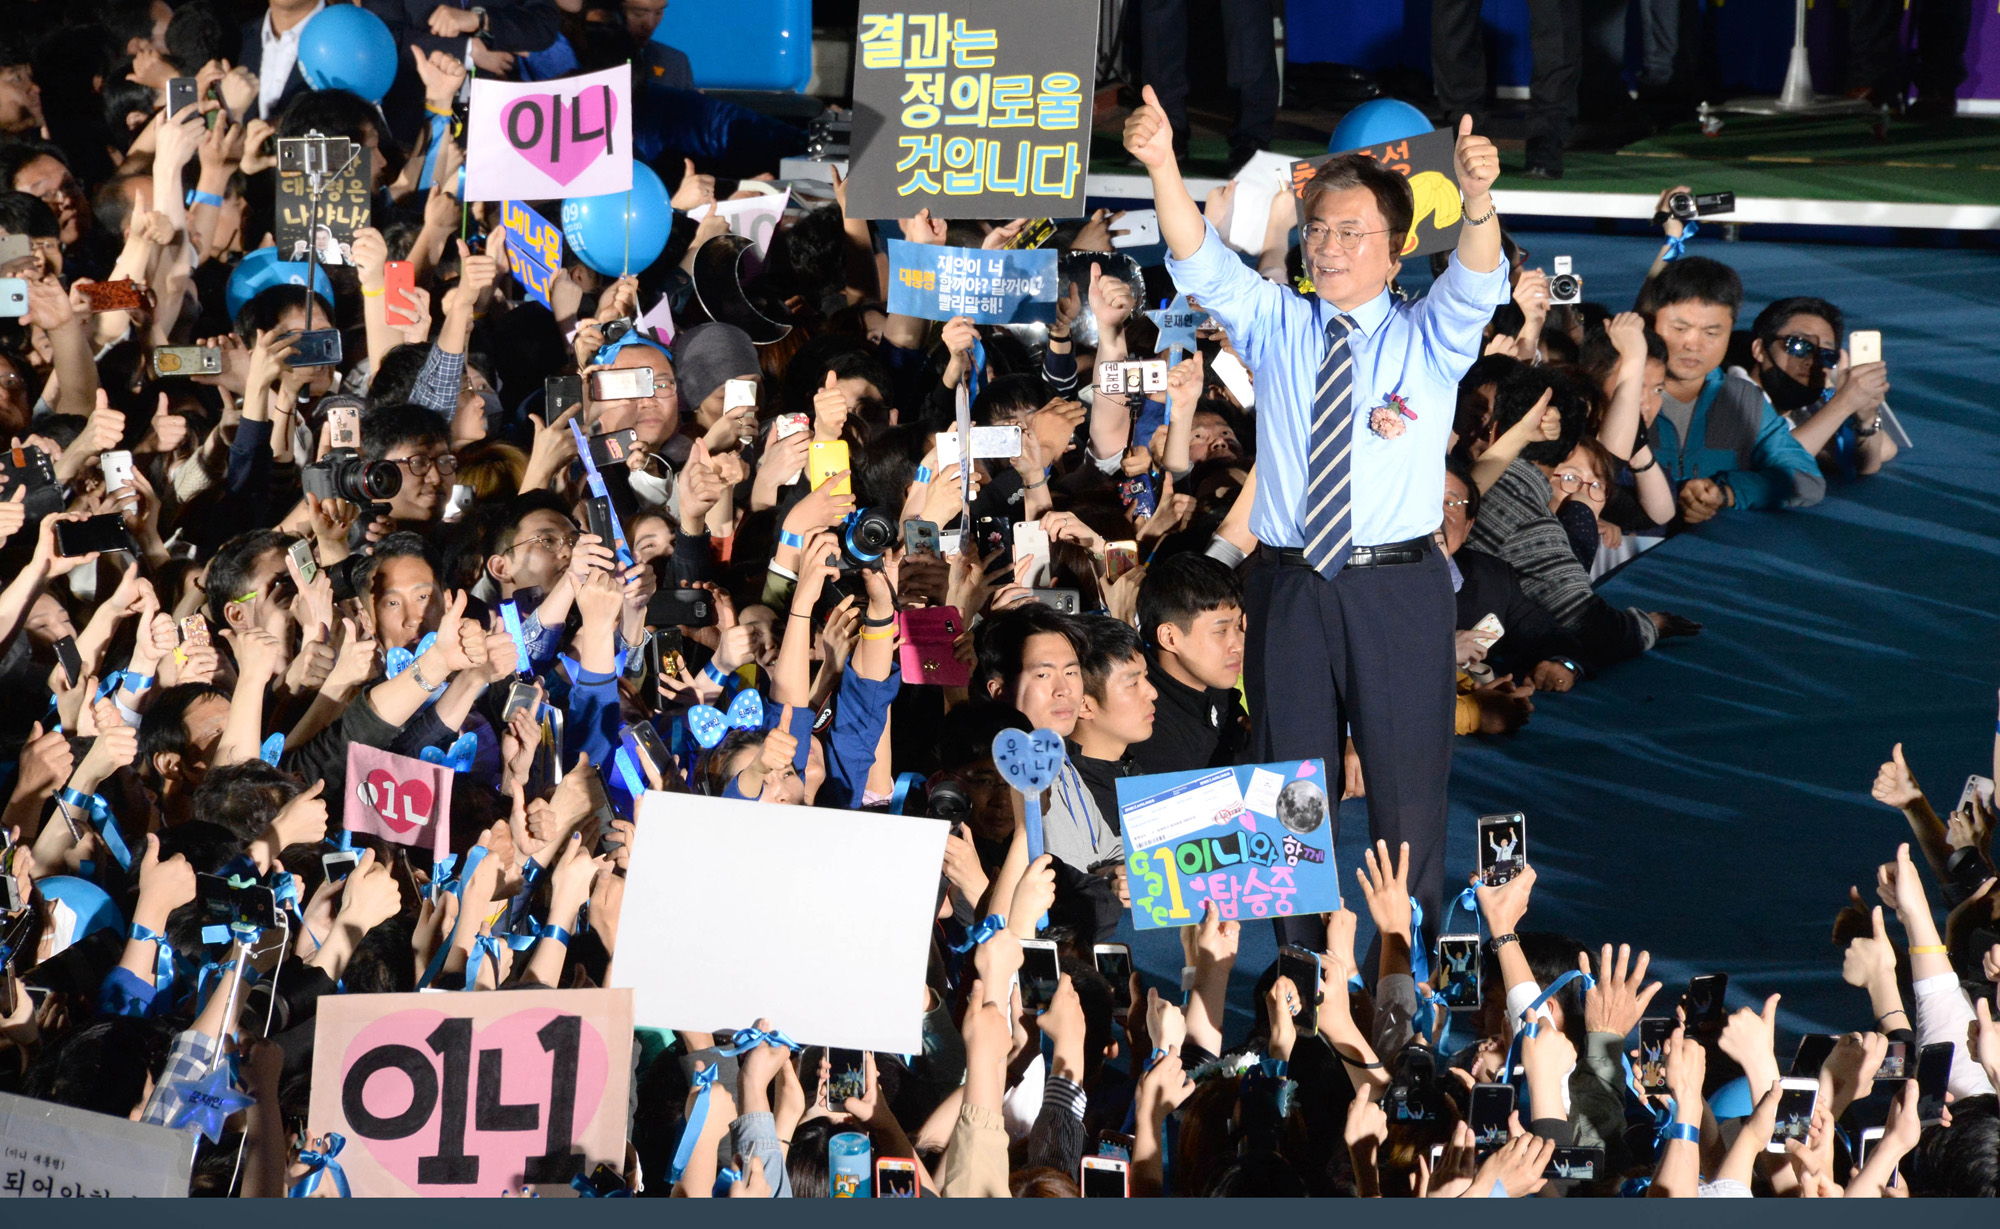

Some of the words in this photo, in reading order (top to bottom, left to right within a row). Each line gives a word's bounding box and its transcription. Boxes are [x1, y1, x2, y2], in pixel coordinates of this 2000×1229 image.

[860, 13, 998, 69] 결과는
[900, 72, 1082, 129] 정의로울
[507, 85, 613, 163] 이니
[896, 134, 1082, 198] 것입니다
[283, 204, 370, 229] 나야나!
[937, 255, 981, 277] 재인이
[988, 258, 1004, 277] 너
[899, 268, 935, 291] 대통령
[938, 272, 989, 295] 할꺼야?
[938, 293, 1003, 314] 빨리말해!
[1164, 314, 1193, 328] 문재인
[1105, 363, 1120, 392] 문재인
[1007, 738, 1051, 756] 우리
[1009, 758, 1053, 776] 이니
[1176, 831, 1279, 874] 이니와
[1283, 835, 1324, 867] 함께
[1153, 847, 1190, 918] 1
[1208, 866, 1297, 919] 탑승중
